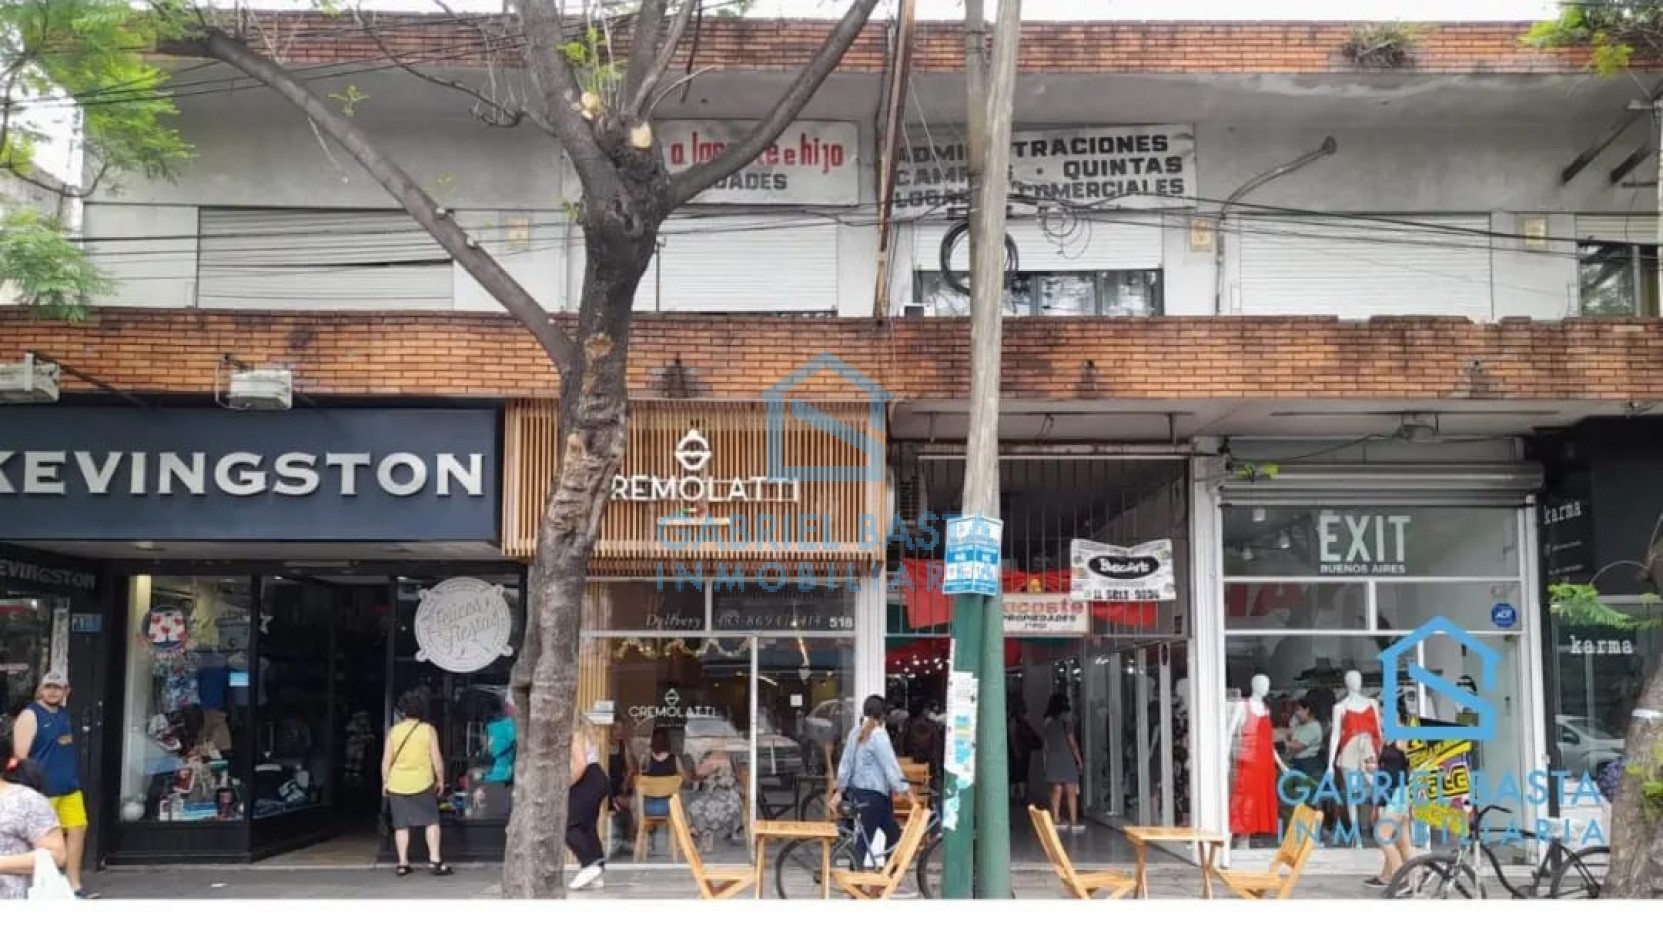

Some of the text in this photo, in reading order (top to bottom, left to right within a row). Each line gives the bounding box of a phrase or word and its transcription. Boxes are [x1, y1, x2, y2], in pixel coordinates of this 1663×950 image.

[783, 147, 796, 165] e
[800, 132, 844, 173] hijo
[1063, 156, 1183, 180] QUINTAS
[1544, 501, 1582, 525] karma
[1318, 515, 1411, 563] EXIT
[1319, 564, 1405, 574] BUENOS AIRES
[1570, 634, 1633, 654] karma
[628, 706, 716, 718] CREMOLATTI
